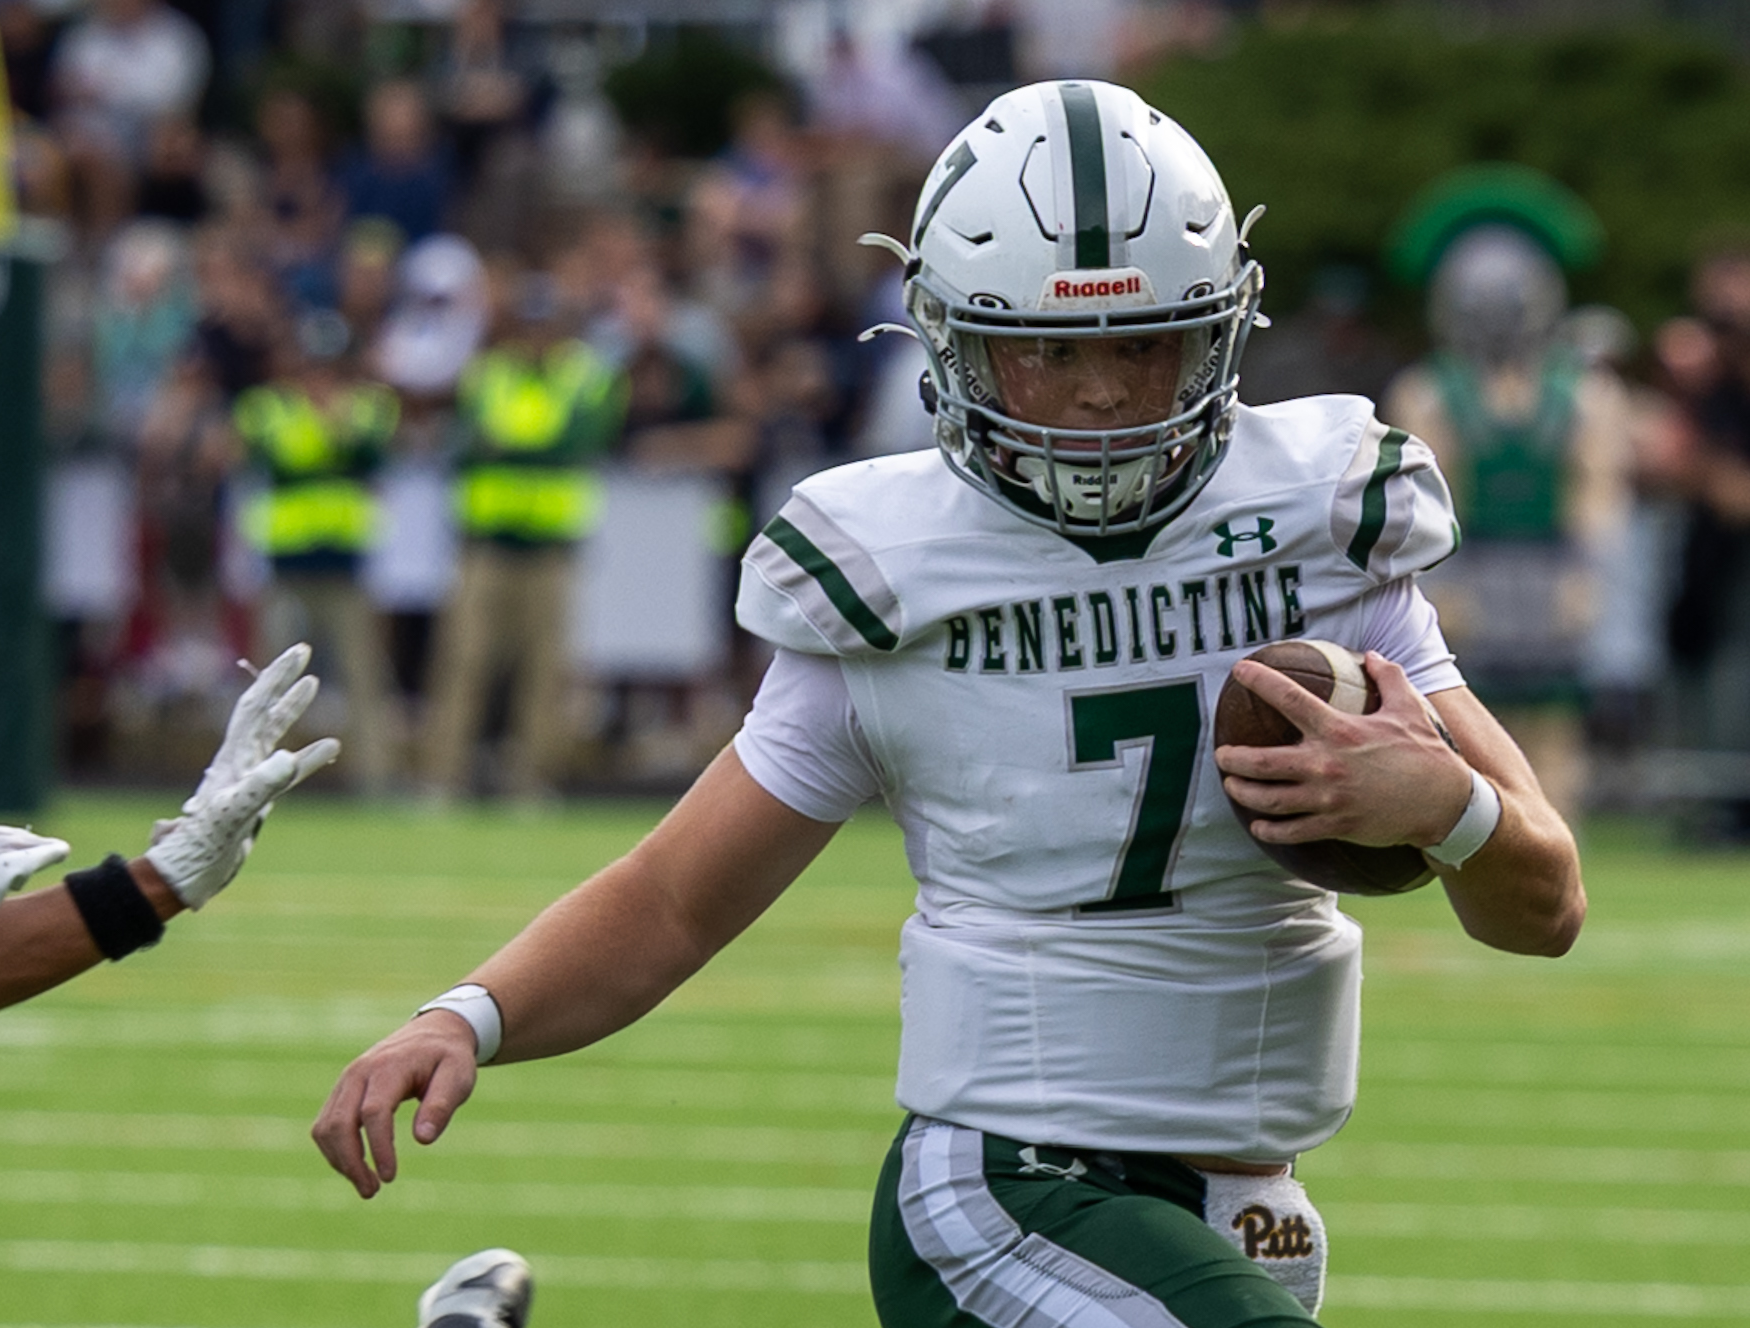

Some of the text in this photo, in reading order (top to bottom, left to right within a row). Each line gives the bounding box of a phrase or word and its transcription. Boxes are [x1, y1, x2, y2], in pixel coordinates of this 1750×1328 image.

[1054, 276, 1141, 298] Riddell
[1072, 473, 1118, 486] Riddll
[943, 562, 1307, 676] BENEDICTINE
[1062, 672, 1210, 922] 7
[1231, 1204, 1314, 1260] Pitt
